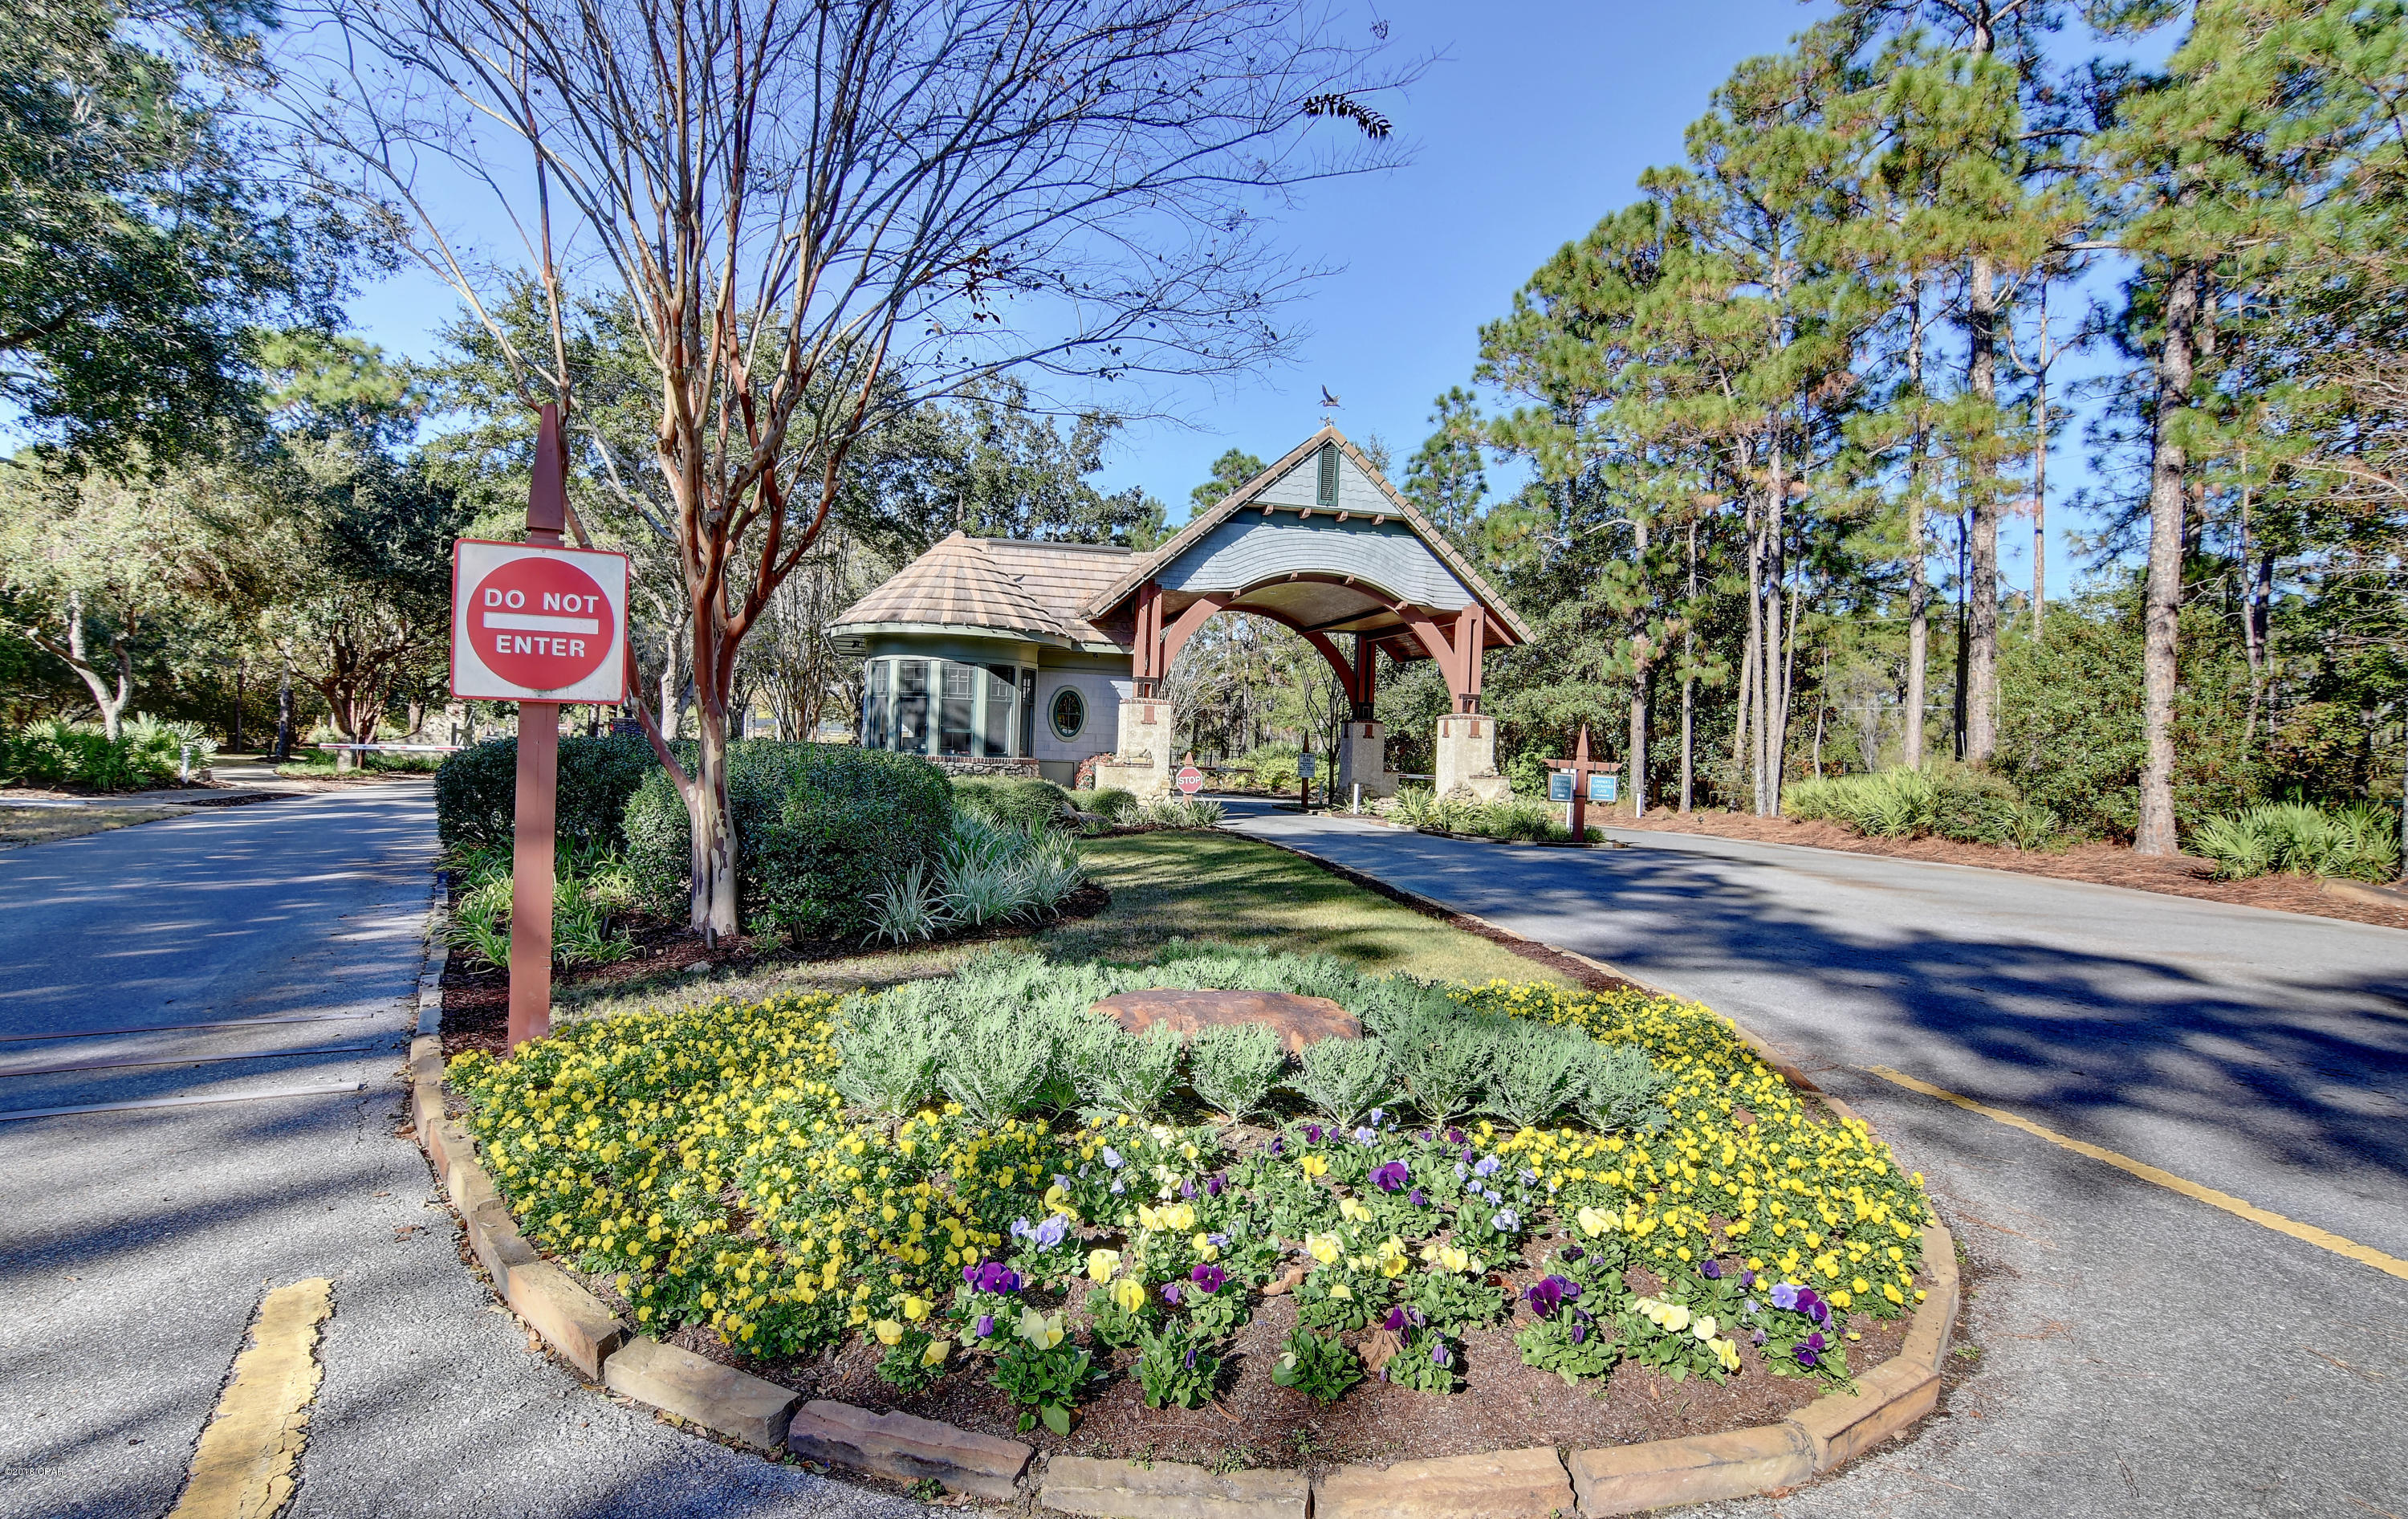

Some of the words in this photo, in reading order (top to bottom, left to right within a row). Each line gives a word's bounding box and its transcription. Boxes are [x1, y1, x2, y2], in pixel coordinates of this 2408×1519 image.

[484, 588, 526, 609] DO
[543, 592, 600, 613] NOT
[496, 634, 586, 658] ENTER
[1178, 776, 1201, 784] STOP
